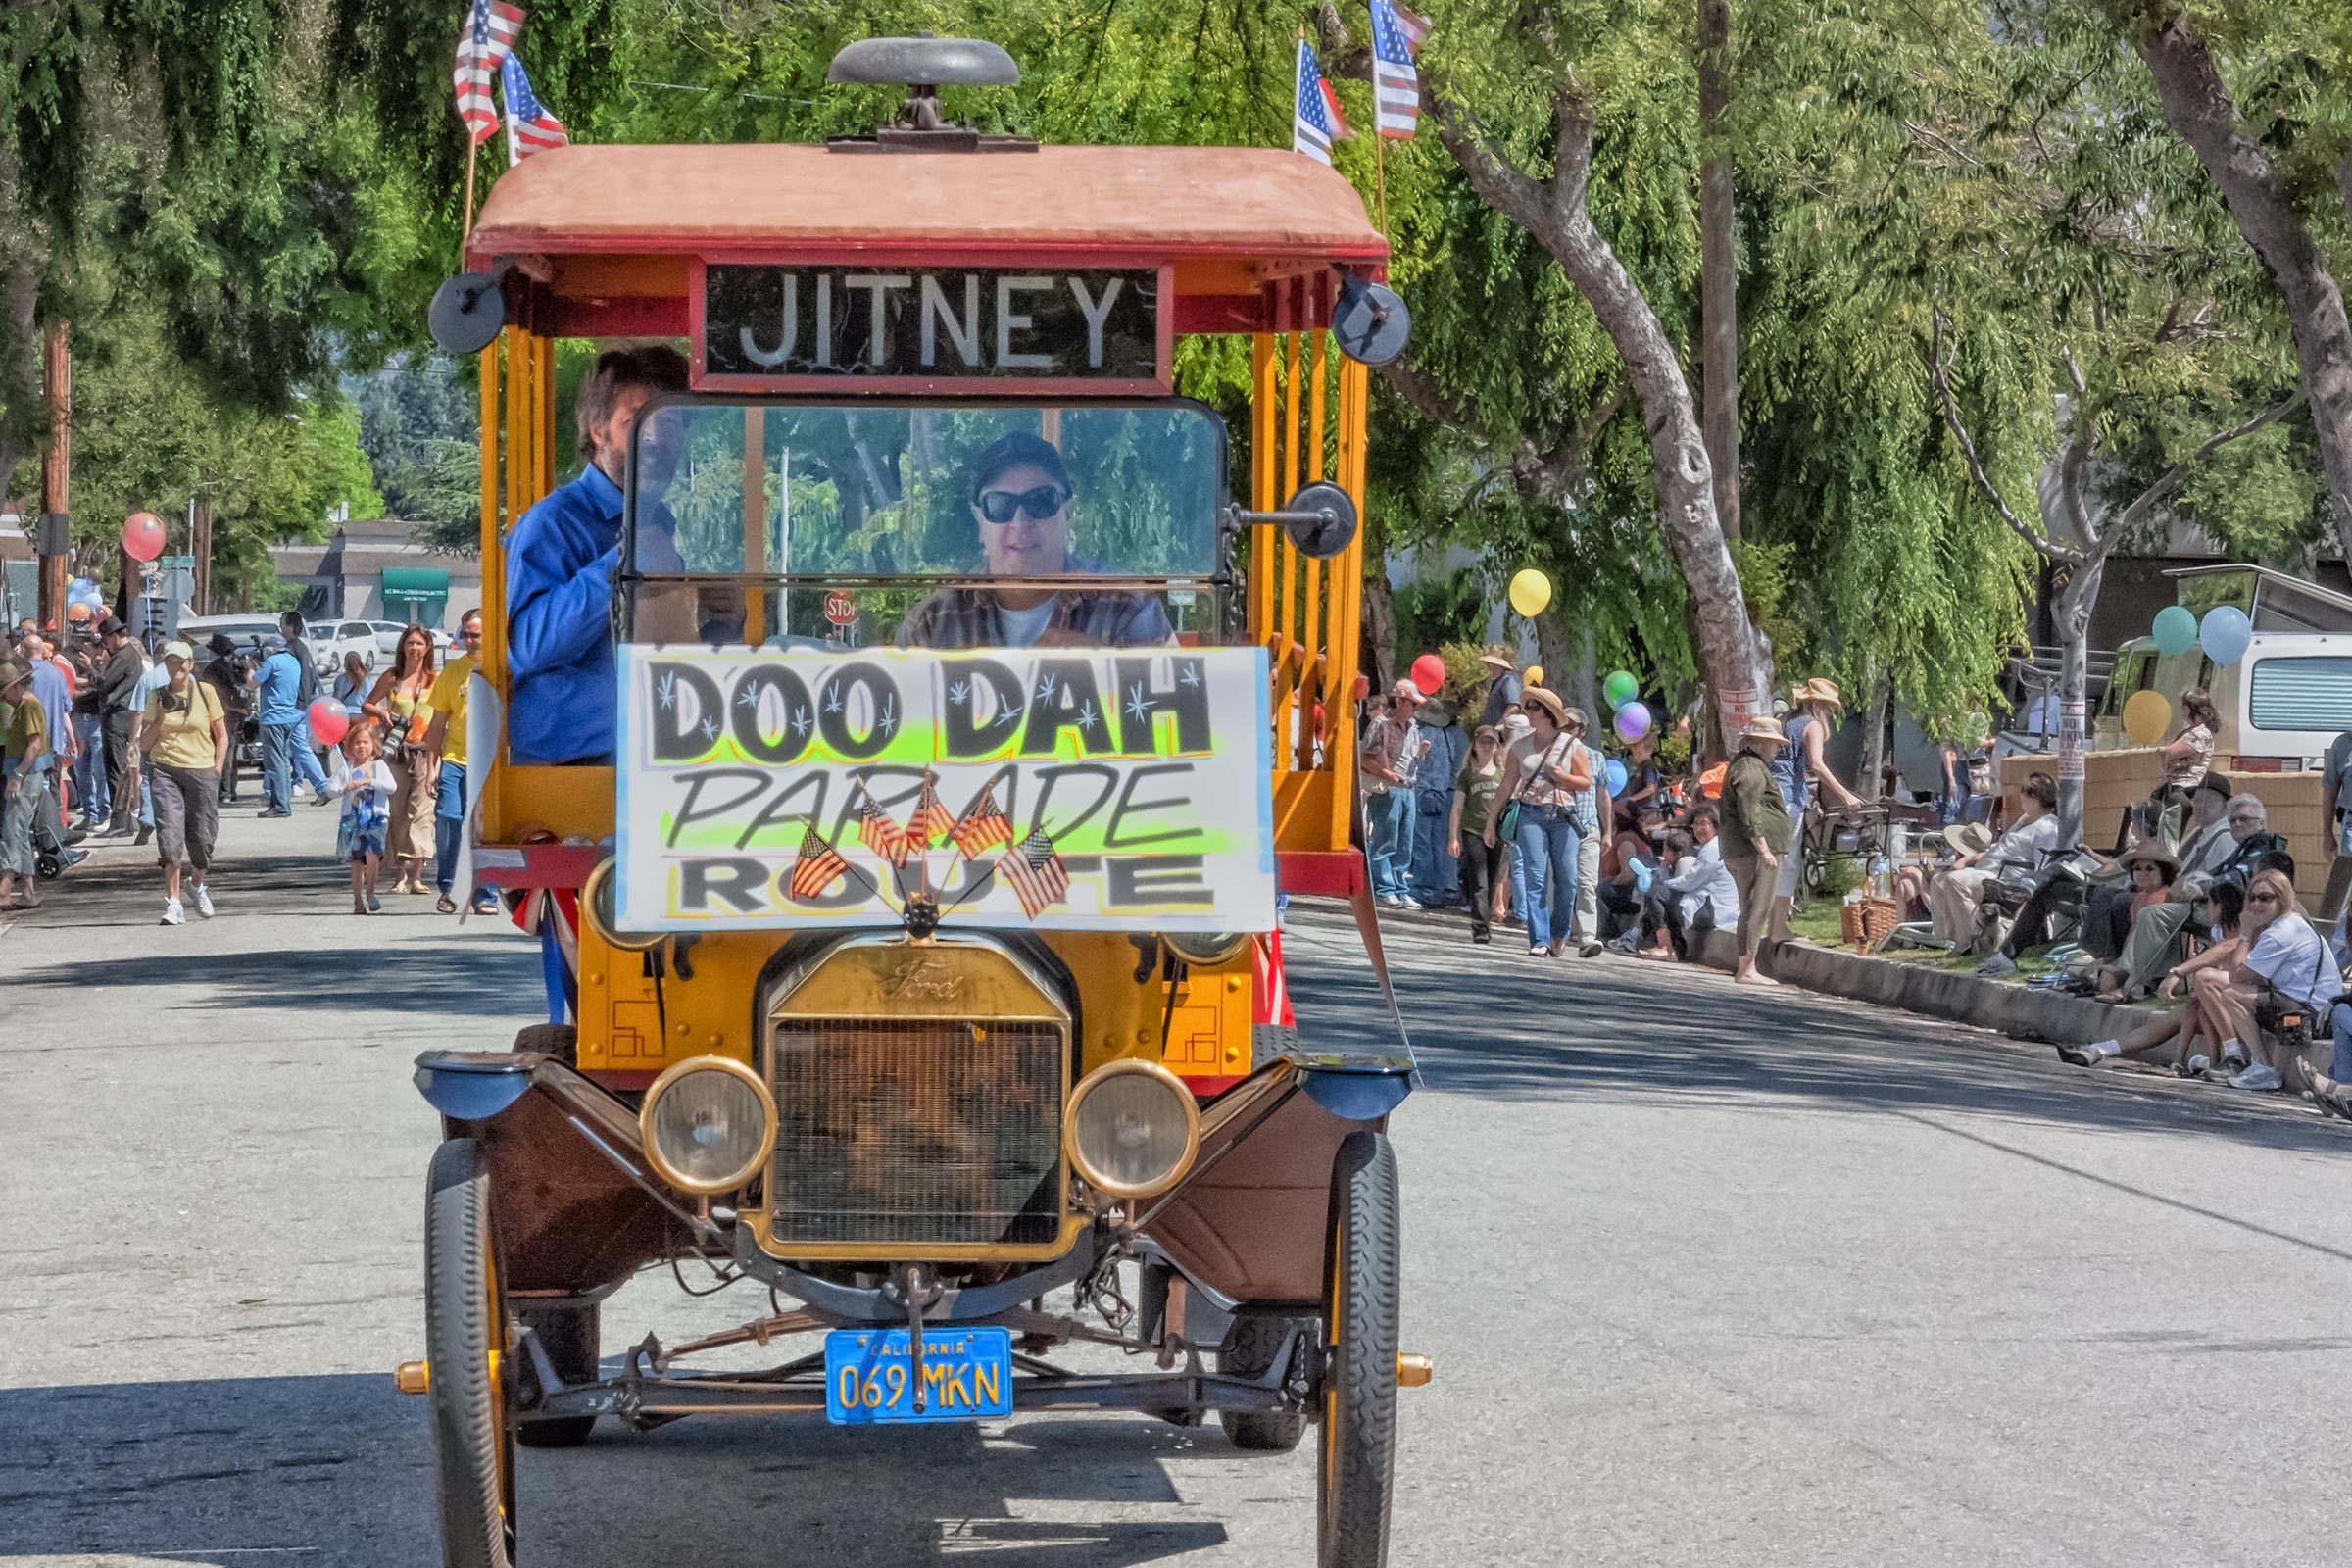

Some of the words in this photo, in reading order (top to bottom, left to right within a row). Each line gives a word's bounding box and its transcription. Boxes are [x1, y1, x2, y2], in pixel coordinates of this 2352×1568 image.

[740, 274, 1124, 368] JITNEY
[648, 660, 903, 762] DOO
[938, 656, 1212, 758] DAH
[1734, 704, 1746, 713] NO
[2063, 718, 2077, 730] NO
[666, 761, 1204, 850] PARADE
[879, 956, 964, 1000] Ford
[871, 1342, 965, 1357] CALIRNIA
[839, 1364, 906, 1409] 069
[922, 1363, 1000, 1407] MKN
